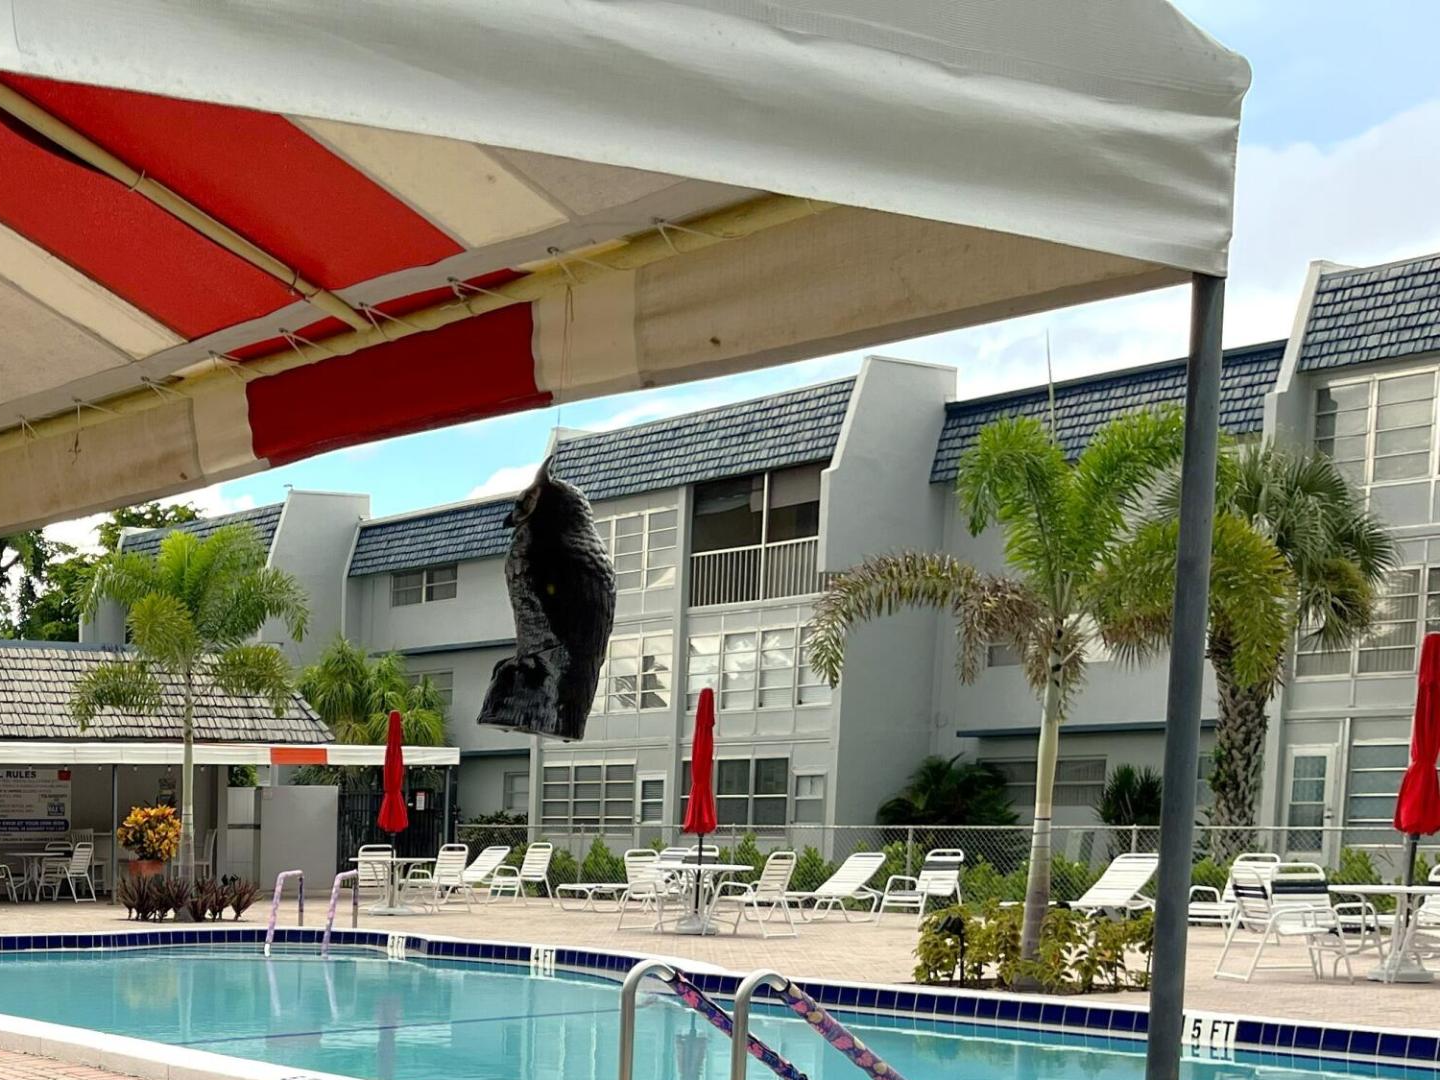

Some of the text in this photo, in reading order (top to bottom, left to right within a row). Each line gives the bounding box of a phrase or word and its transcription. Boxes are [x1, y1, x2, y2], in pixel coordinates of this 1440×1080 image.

[6, 770, 36, 778] RULES
[534, 948, 554, 964] 4 FT
[1191, 1018, 1235, 1041] 5 FT
